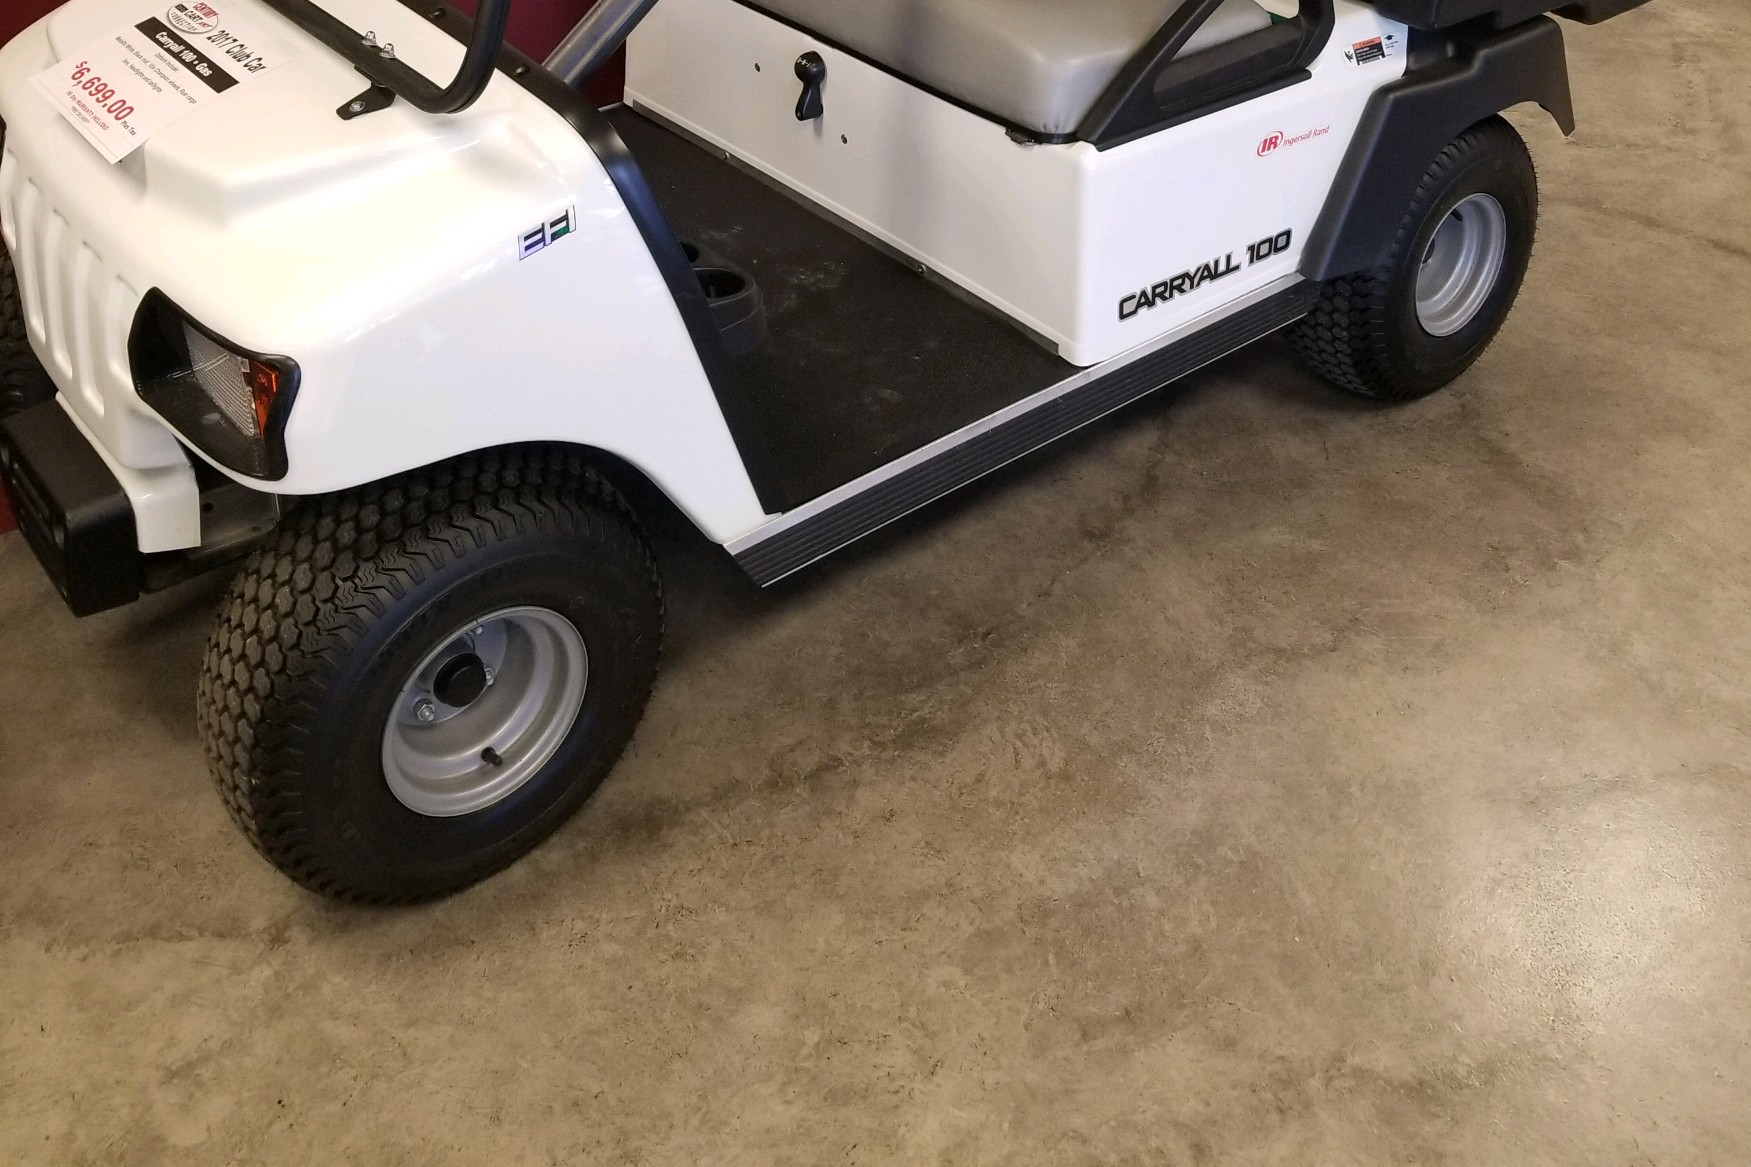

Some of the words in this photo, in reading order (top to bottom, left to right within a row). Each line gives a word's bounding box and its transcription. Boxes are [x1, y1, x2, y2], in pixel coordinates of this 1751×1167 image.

[183, 10, 203, 23] CART
[155, 31, 186, 53] Carryall
[178, 49, 197, 63] 100
[195, 62, 213, 77] Gas
[205, 29, 239, 49] 2017
[225, 43, 254, 63] Club
[242, 57, 267, 74] Car
[71, 61, 135, 121] $6,699.00
[120, 120, 130, 130] Plus
[128, 126, 137, 136] Tax
[1260, 135, 1280, 153] IR
[1283, 129, 1312, 147] Ingersoll
[1312, 124, 1330, 139] Rand
[1118, 251, 1242, 322] CARRYALL
[1246, 227, 1293, 267] 100
